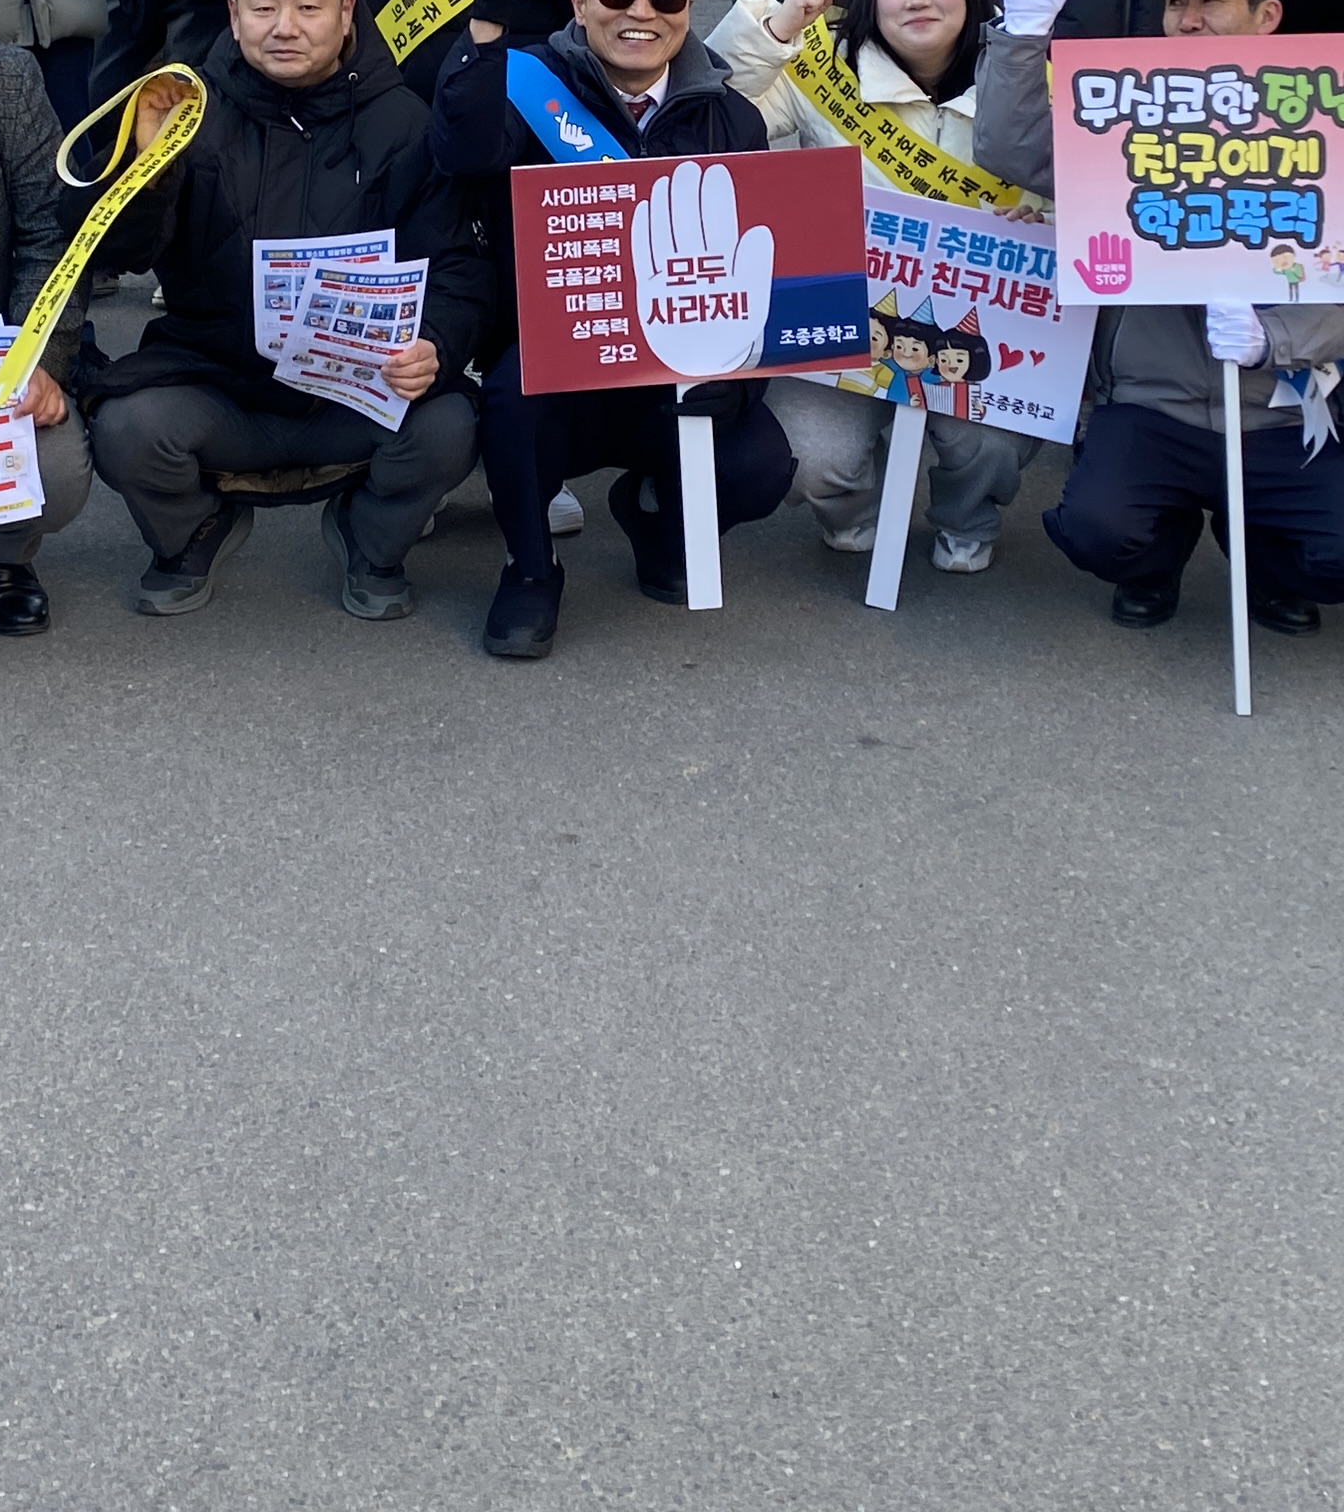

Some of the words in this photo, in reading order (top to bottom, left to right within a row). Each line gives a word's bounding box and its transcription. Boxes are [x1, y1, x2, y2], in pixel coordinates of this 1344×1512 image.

[392, 1, 442, 54] 주세요
[814, 84, 877, 150] 고등학교
[877, 146, 950, 202] 학생들을
[877, 119, 938, 168] 보호해
[938, 164, 999, 205] 주세요
[1128, 132, 1320, 185] 친구에게
[541, 183, 637, 209] 사이버폭력
[547, 211, 624, 235] 언어폭력
[1133, 190, 1319, 246] 학교폭력
[544, 237, 621, 262] 신체폭력
[865, 208, 927, 253] 폭력
[937, 225, 1058, 281] 추방하자
[545, 264, 623, 289] 금품갈취
[666, 255, 728, 287] 모두
[1094, 263, 1127, 274] 학교폭력
[1095, 273, 1127, 287] STOP
[866, 248, 924, 289] 하자
[931, 270, 1063, 323] 친구사랑!
[565, 291, 624, 313] 따돌림
[646, 291, 749, 326] 사라져!
[571, 316, 630, 340] 성폭력
[779, 324, 860, 346] 조종중학교
[598, 343, 638, 365] 강요
[980, 392, 1056, 421] 조종중학교
